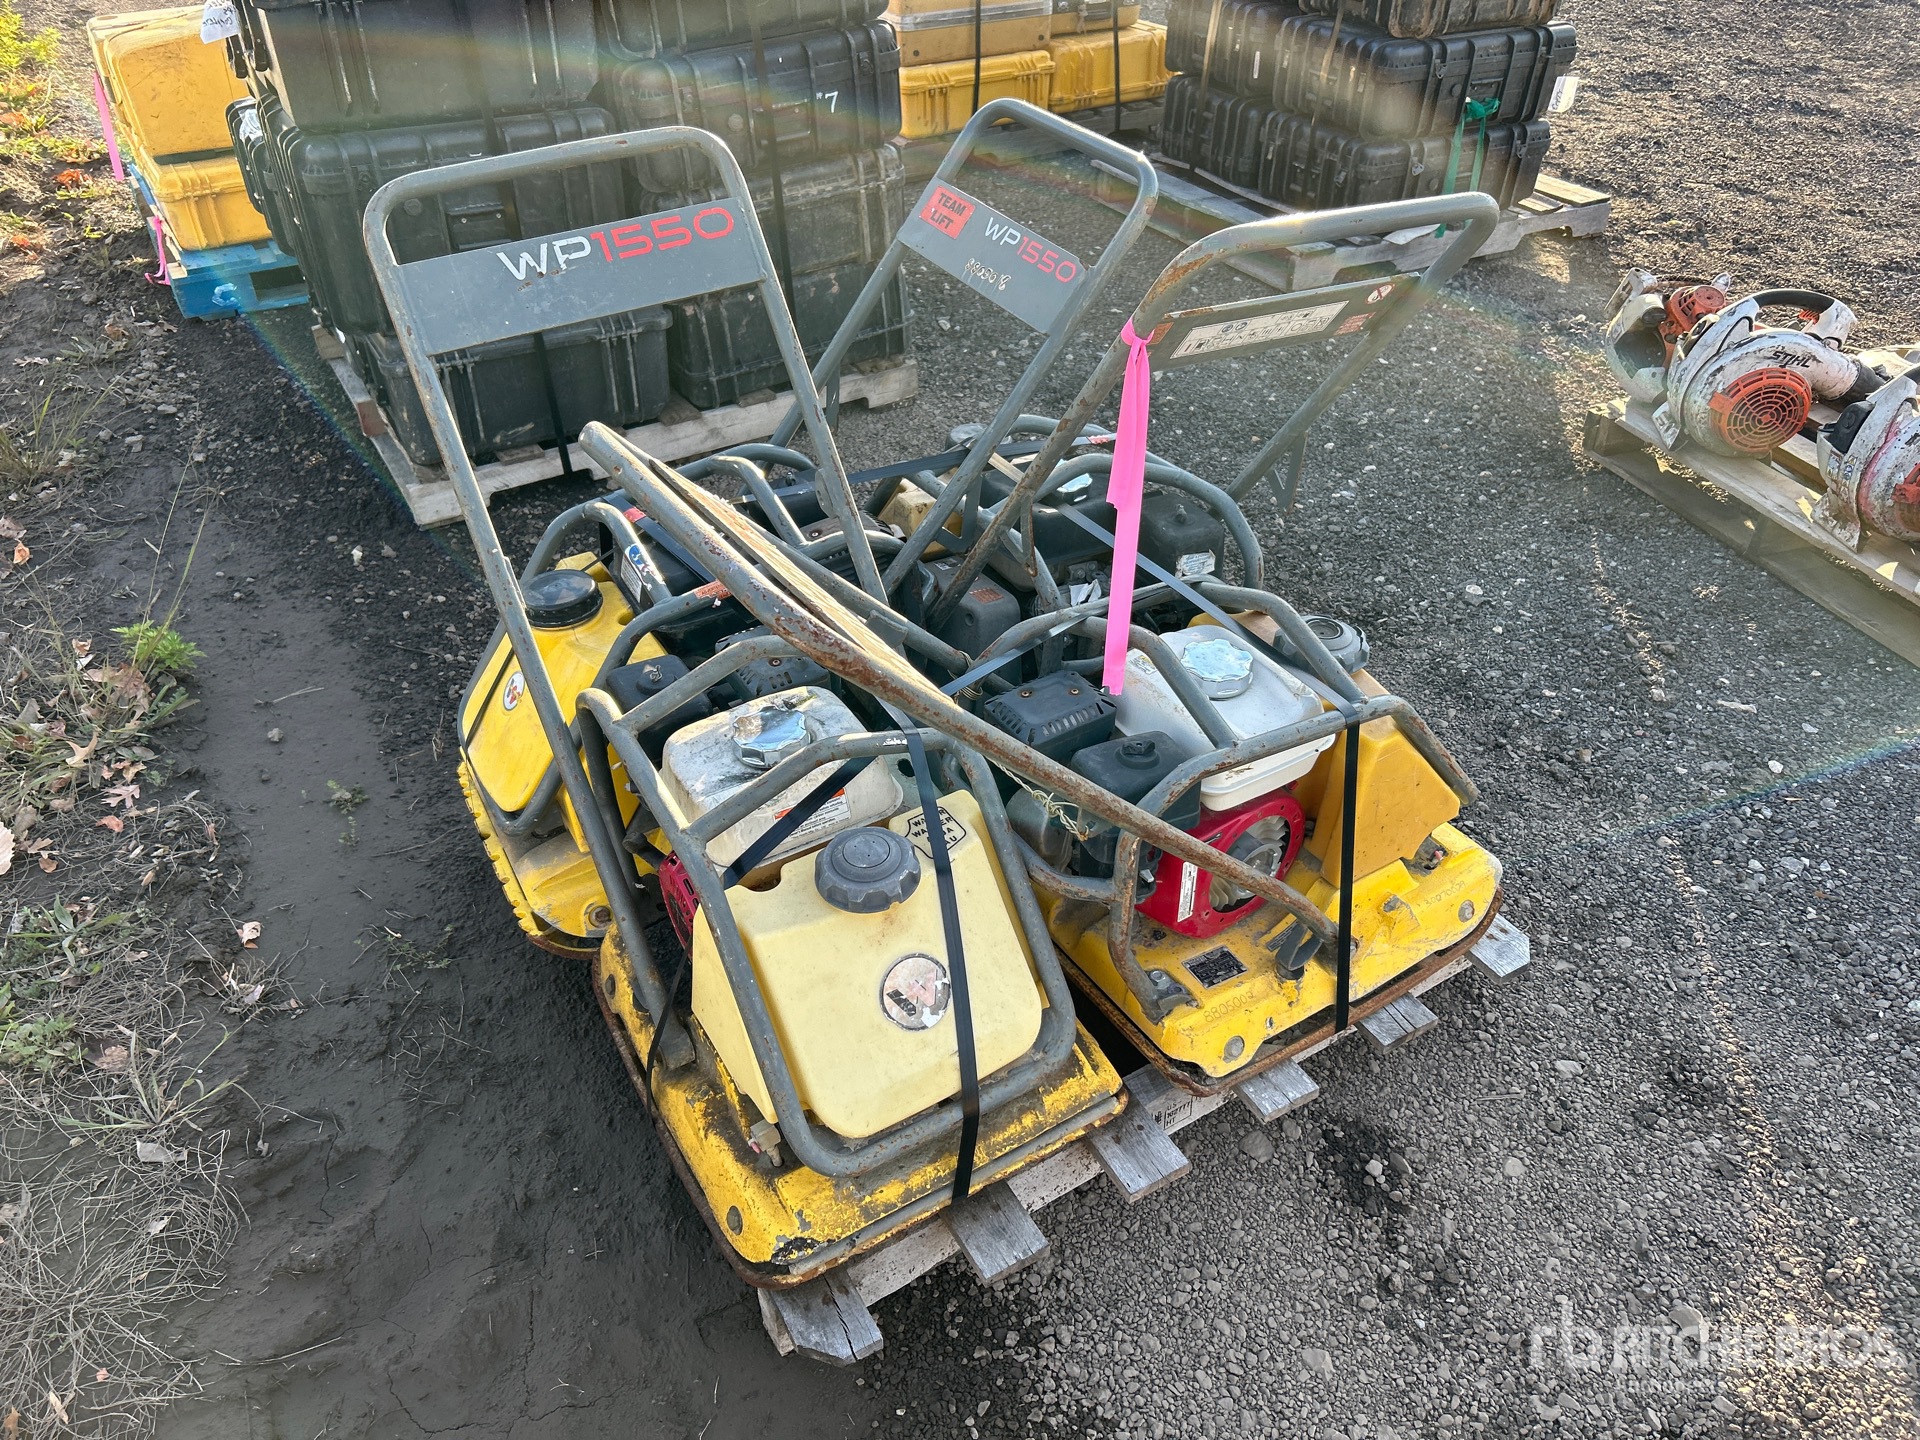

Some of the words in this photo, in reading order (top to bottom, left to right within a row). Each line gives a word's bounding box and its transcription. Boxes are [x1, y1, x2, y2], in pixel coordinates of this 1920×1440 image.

[938, 193, 967, 216] TEAM
[930, 210, 955, 230] LIFT
[496, 207, 735, 281] WP1550
[984, 216, 1077, 283] WP1550
[1772, 350, 1810, 369] STIHL
[911, 816, 953, 838] WAER
